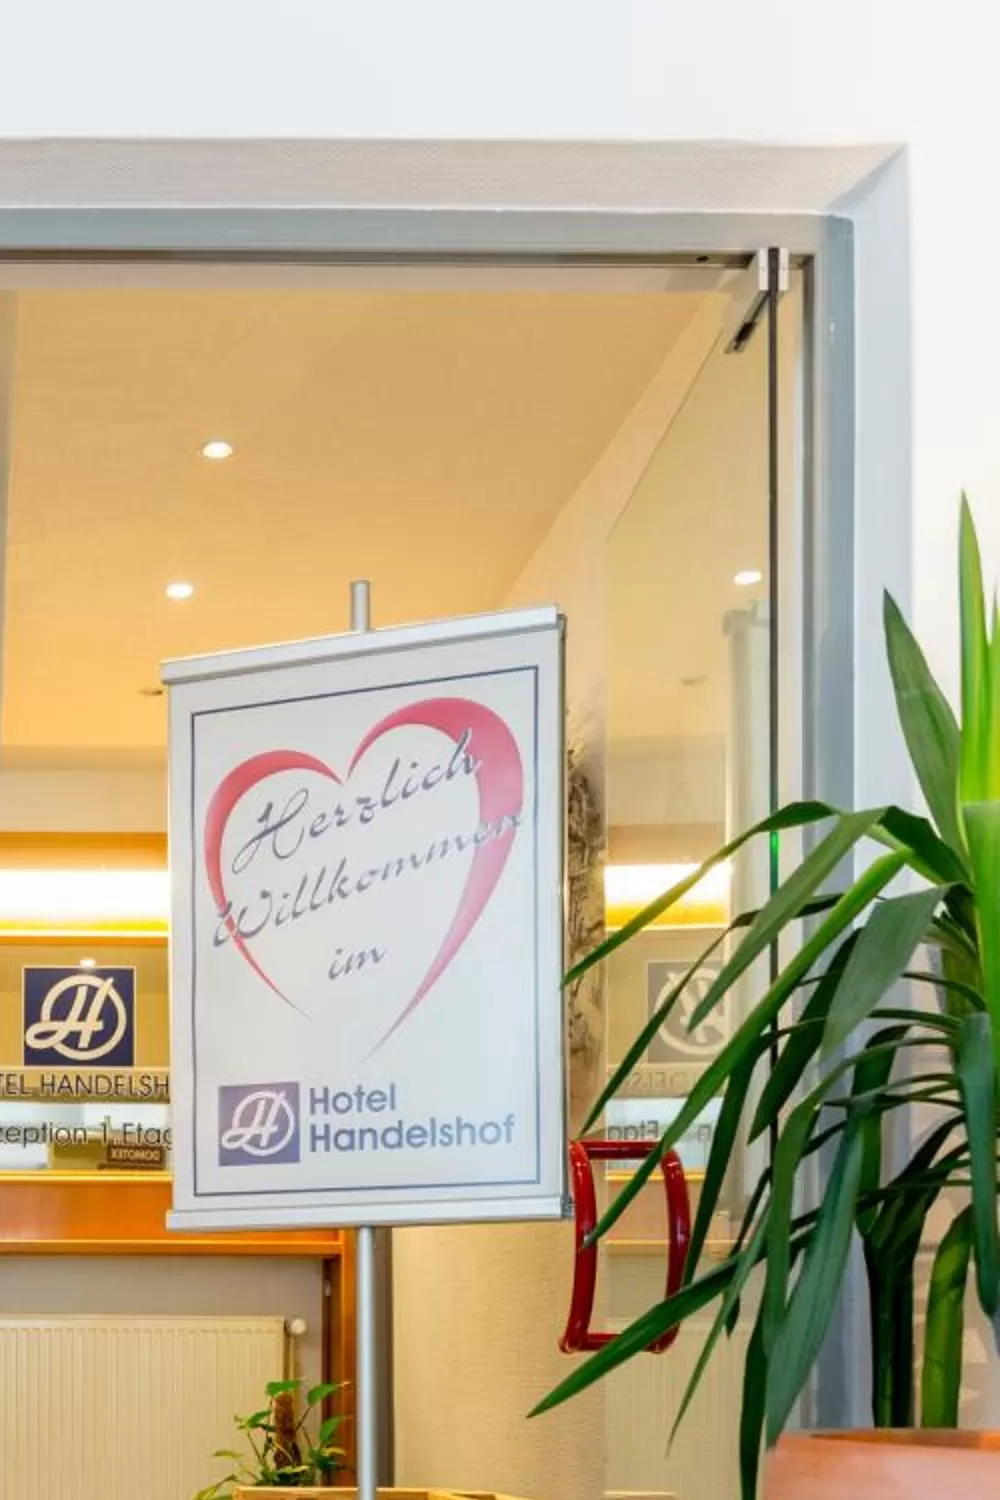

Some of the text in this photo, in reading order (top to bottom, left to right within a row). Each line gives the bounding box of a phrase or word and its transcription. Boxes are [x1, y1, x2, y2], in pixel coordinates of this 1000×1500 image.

[231, 728, 482, 875] Herzlich
[212, 814, 522, 947] Willkommen
[327, 946, 386, 980] im
[40, 1073, 170, 1097] HANDELSH
[309, 1083, 397, 1115] Hotel
[309, 1113, 516, 1153] Handelshof
